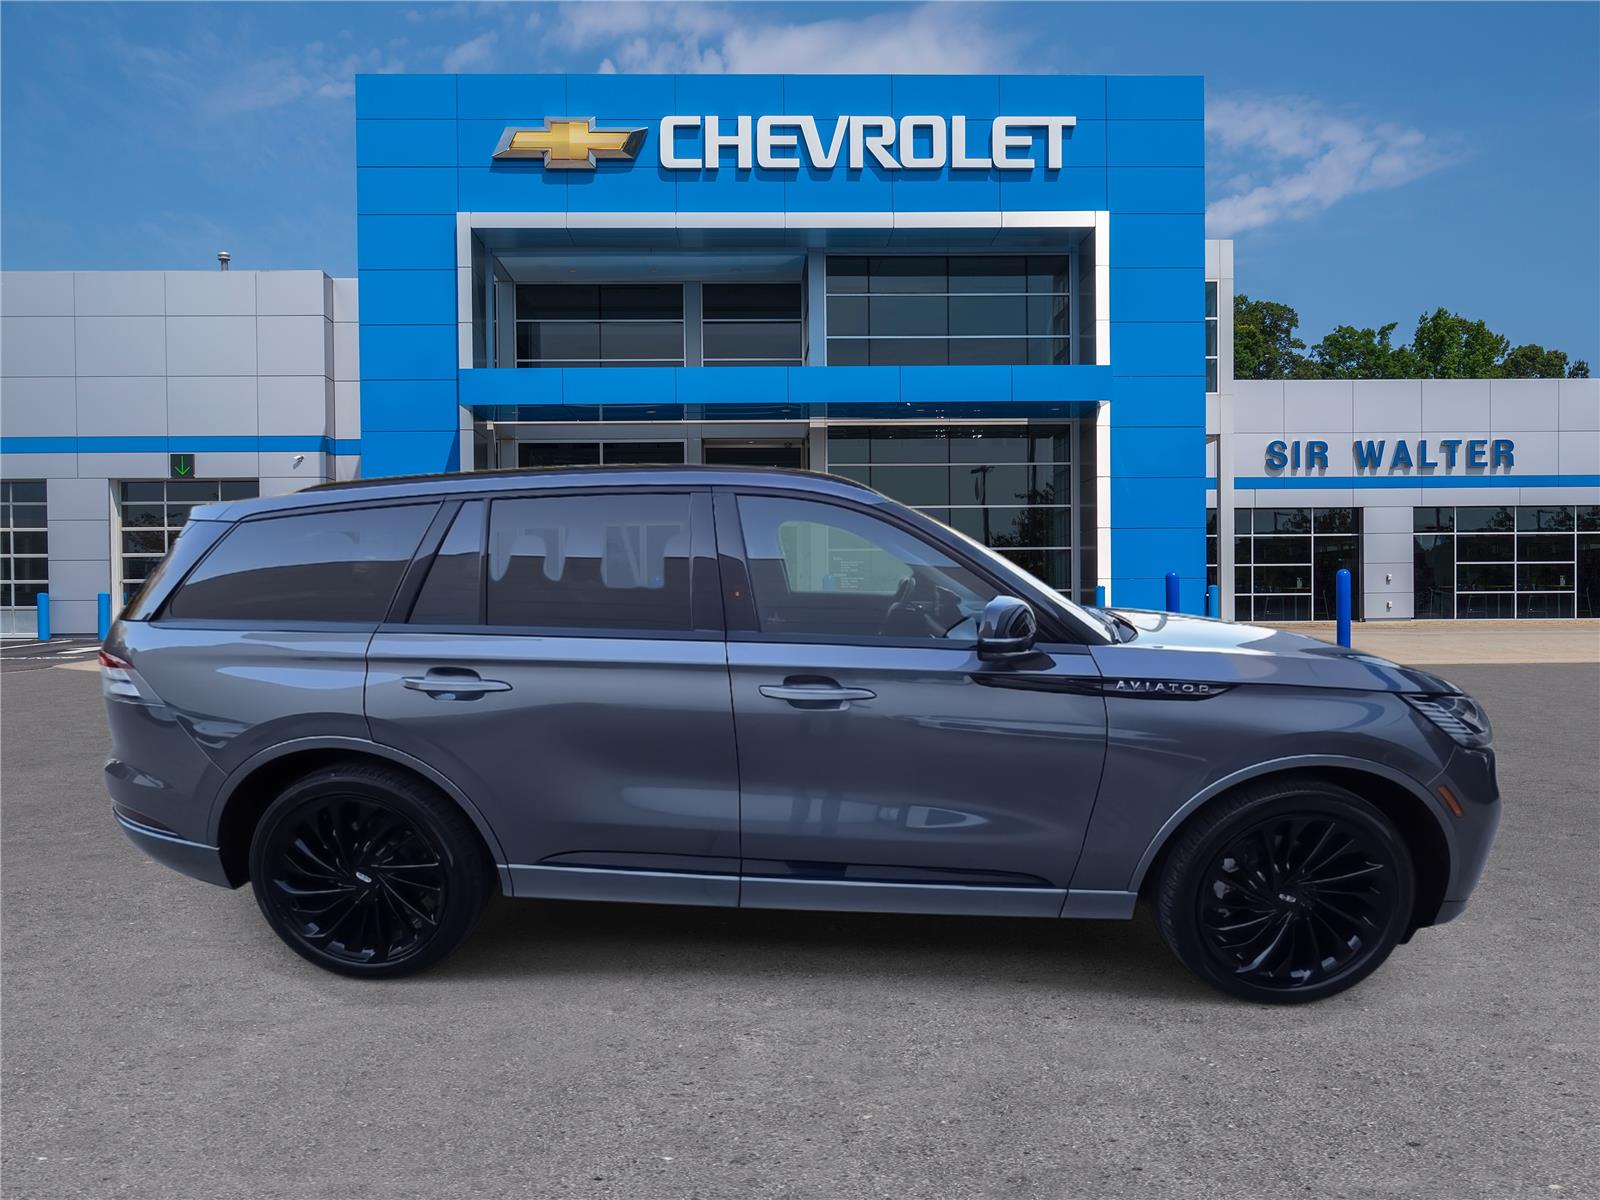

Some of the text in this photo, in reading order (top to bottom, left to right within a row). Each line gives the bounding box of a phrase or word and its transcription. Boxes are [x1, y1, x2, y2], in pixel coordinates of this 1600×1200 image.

[660, 115, 1077, 169] CHEVROLET
[1265, 439, 1515, 470] SIR WALTER
[1116, 680, 1209, 693] AVIATOR
